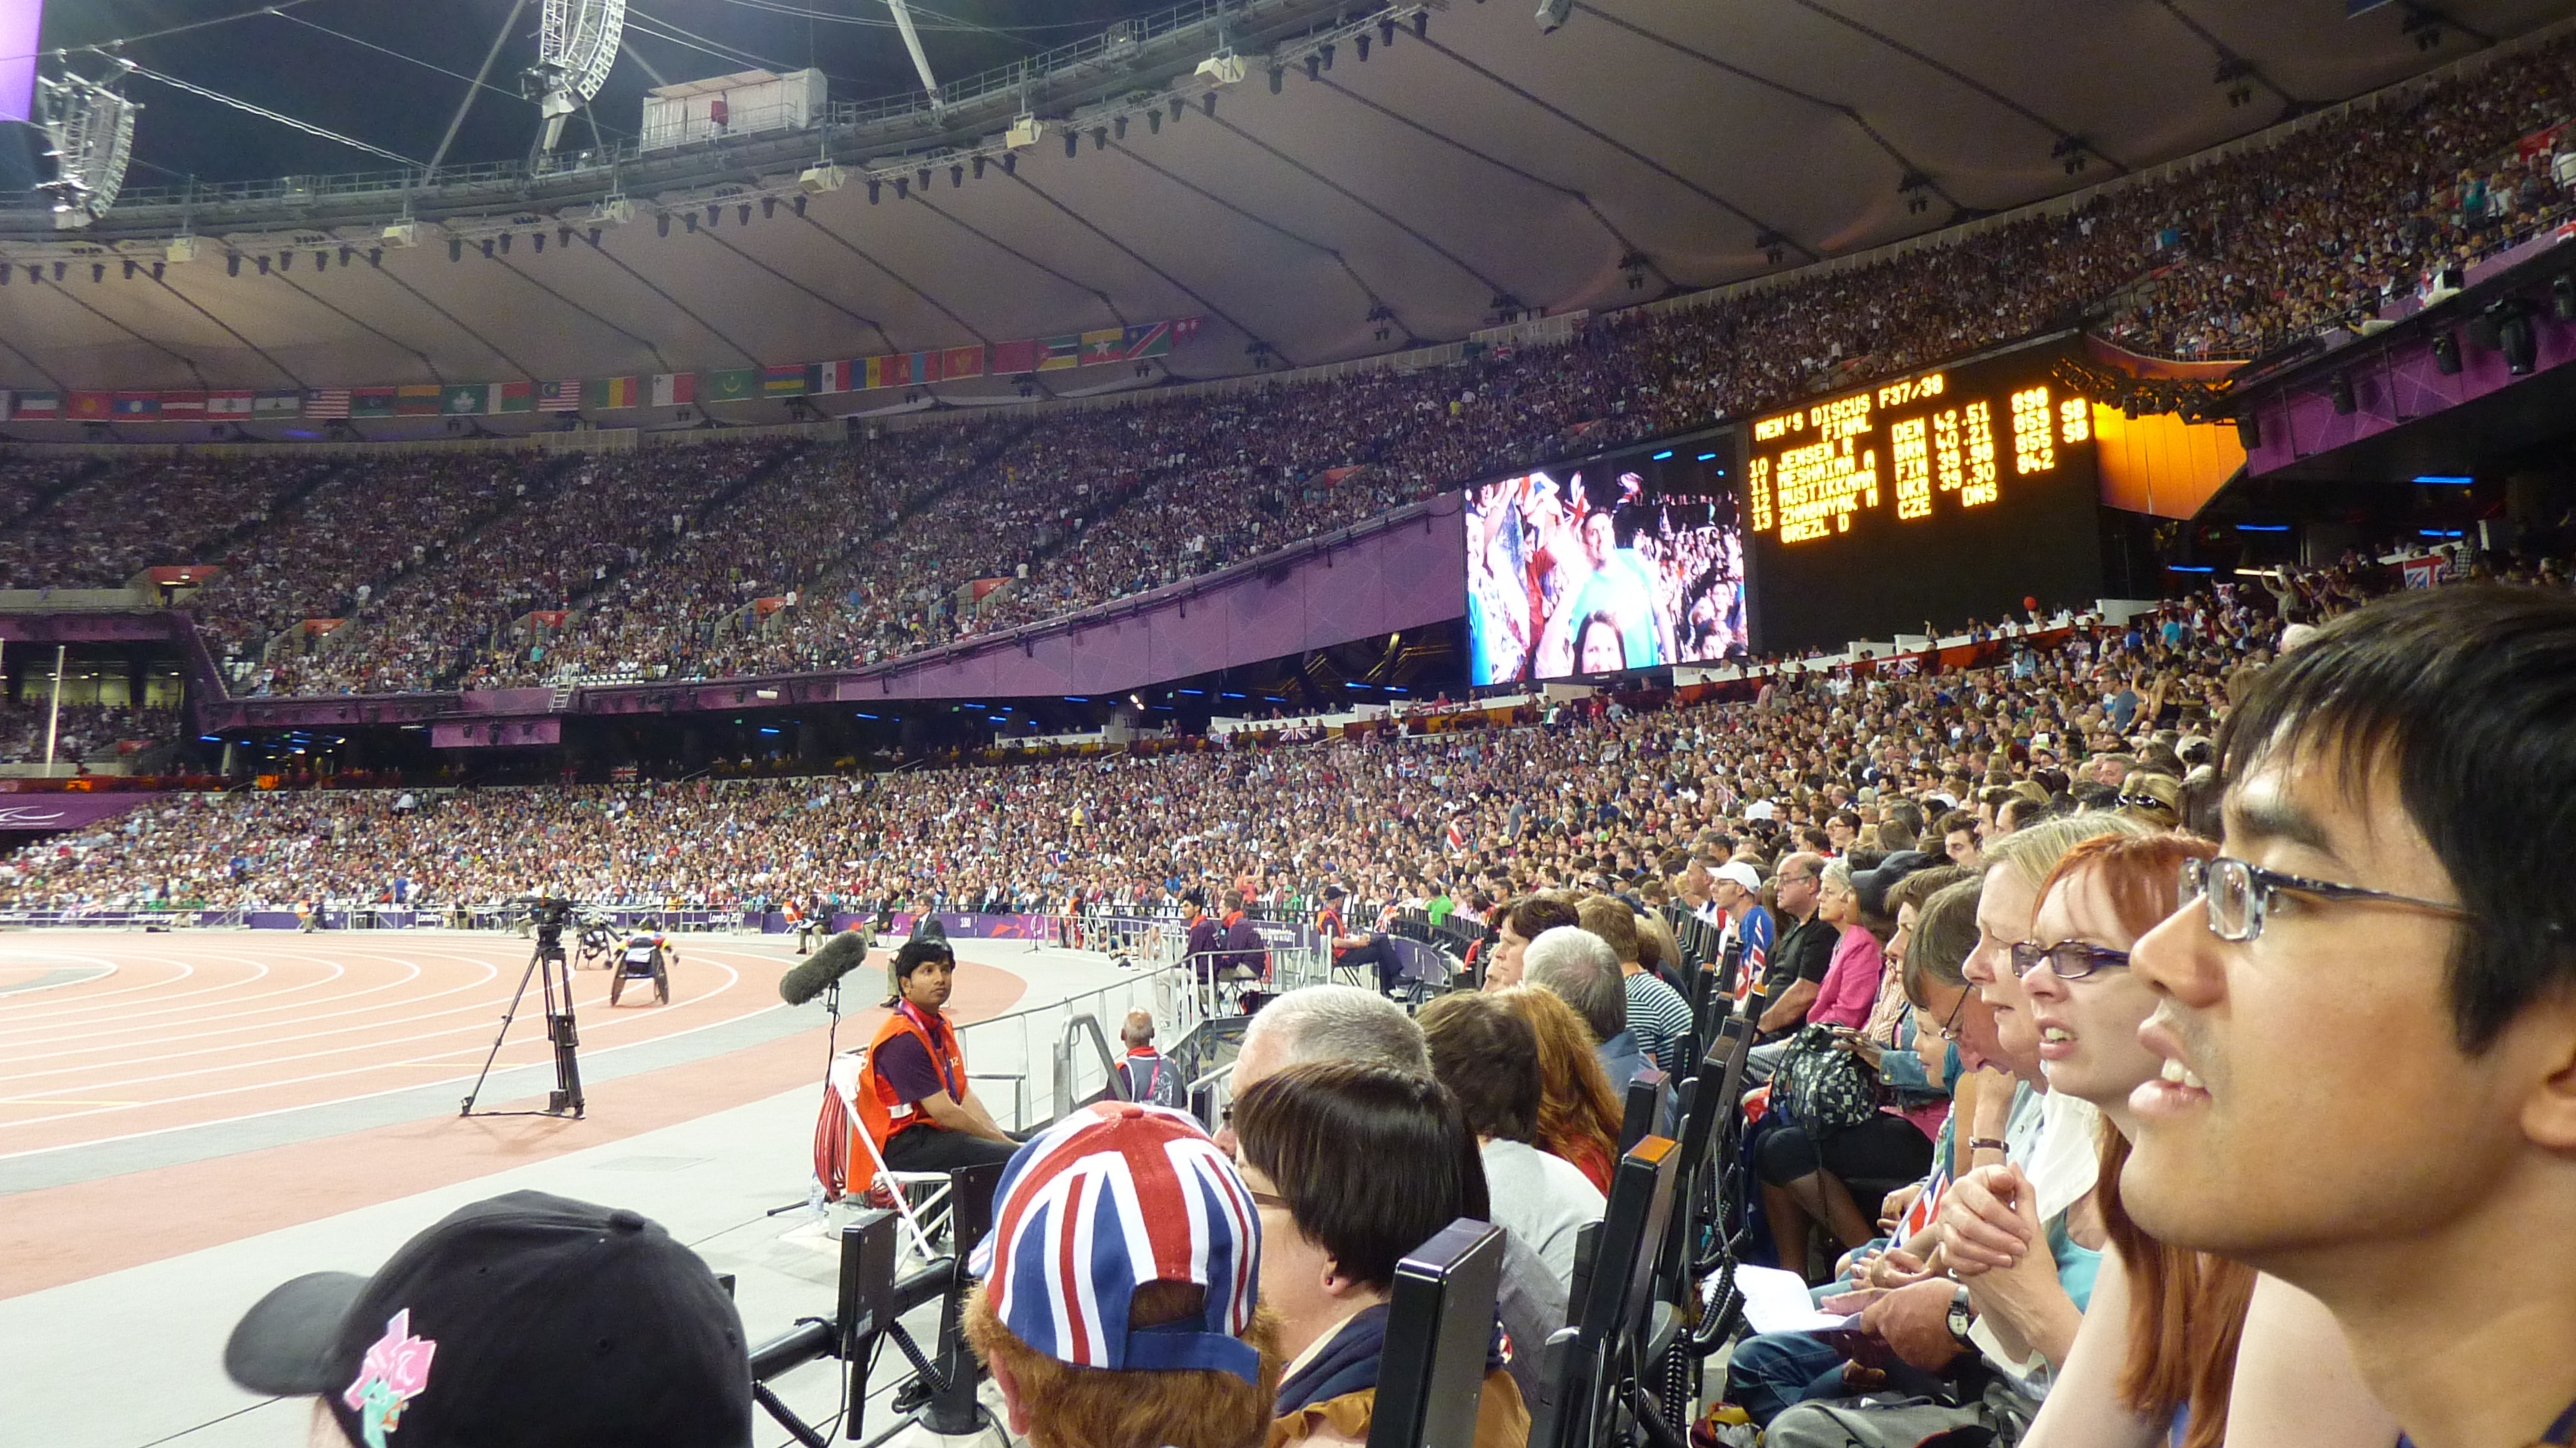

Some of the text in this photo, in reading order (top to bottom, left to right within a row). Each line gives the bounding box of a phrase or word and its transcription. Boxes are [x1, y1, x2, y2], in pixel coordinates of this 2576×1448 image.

[1749, 386, 2048, 478] 10 JENSEN R DEN 42.51 898
[1751, 398, 2087, 496] 11 MESHAIMA A BRN 40.21 859 SB
[1755, 374, 1943, 441] MEN'S DISCUS F37/38
[1822, 413, 1872, 442] FINAL
[1751, 493, 1771, 514] 12
[1895, 456, 1928, 481] FIN
[1937, 441, 1993, 472] 39.98
[2015, 427, 2052, 454] 855
[2062, 419, 2089, 444] SB
[1753, 448, 2055, 532] 13 ZHABNYAK M UKR 39.30 842
[1780, 481, 1998, 544] GREZL D CZE DNS
